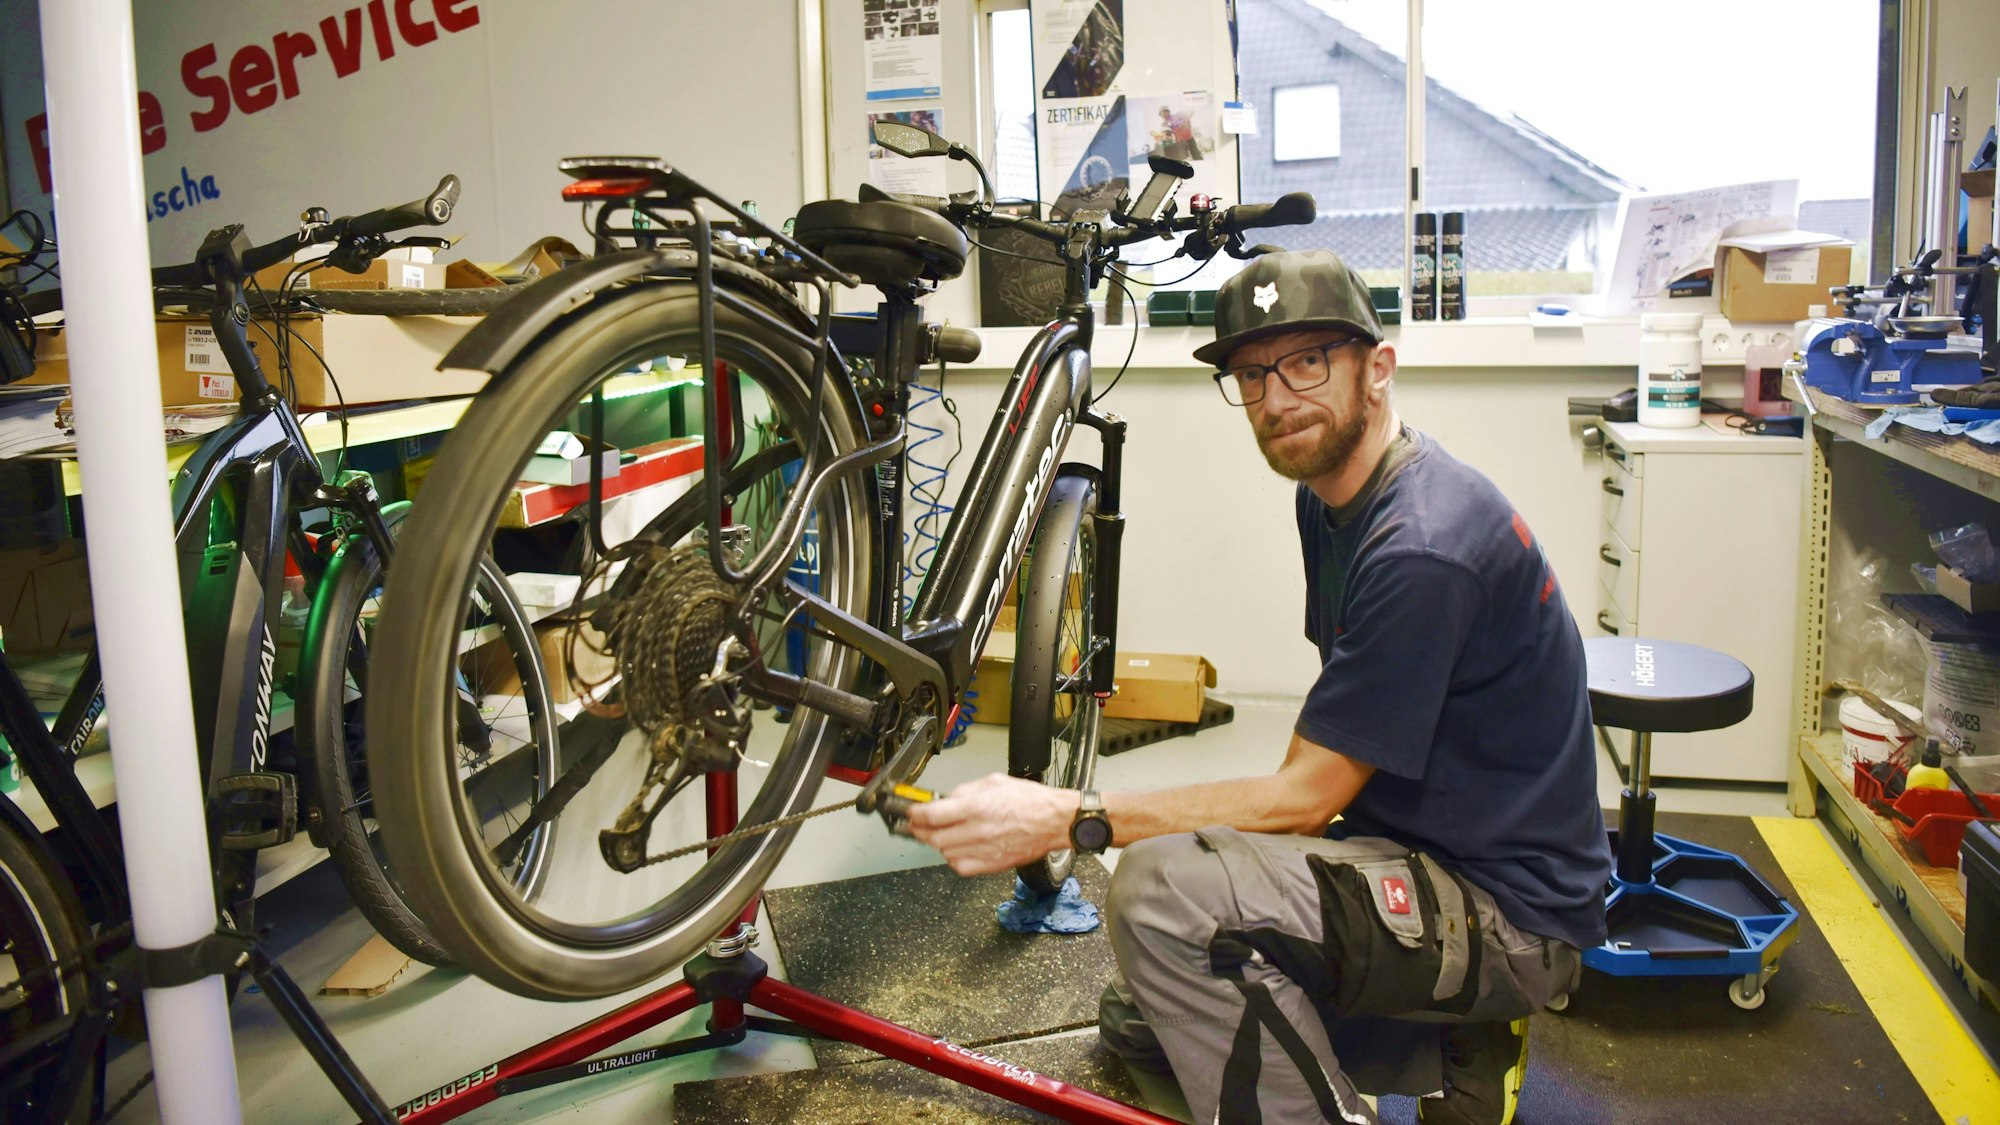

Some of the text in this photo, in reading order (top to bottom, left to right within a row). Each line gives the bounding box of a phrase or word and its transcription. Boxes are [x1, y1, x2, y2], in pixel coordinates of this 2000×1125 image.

[1047, 105, 1109, 123] ZERTIFIKAT
[969, 412, 1065, 666] corratec
[1631, 643, 1655, 687] HÖGERT
[587, 1049, 657, 1073] ULTRALIGHT
[1003, 1069, 1035, 1086] SPORTS
[393, 1062, 498, 1121] FEEDBAC
